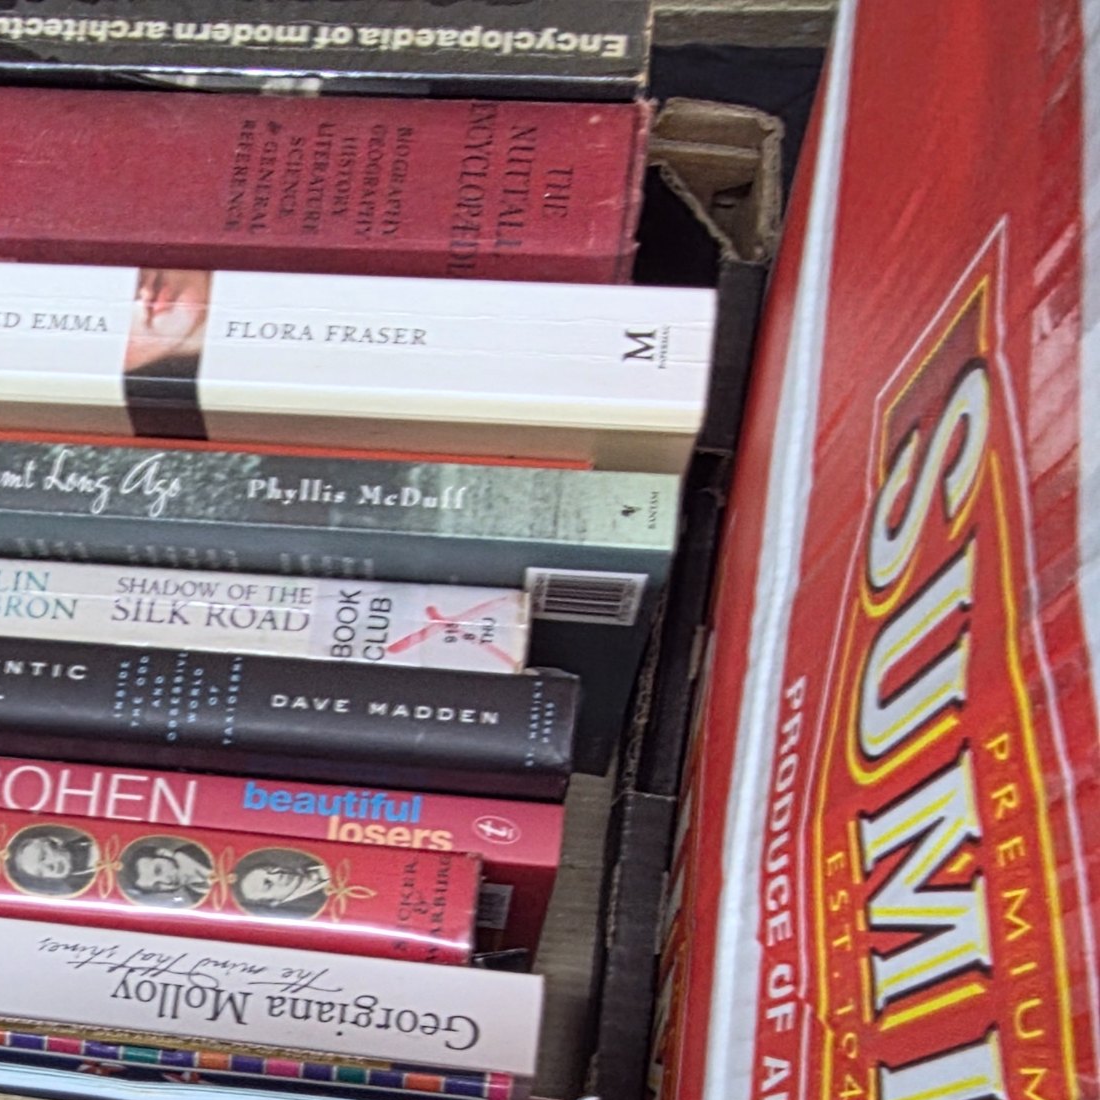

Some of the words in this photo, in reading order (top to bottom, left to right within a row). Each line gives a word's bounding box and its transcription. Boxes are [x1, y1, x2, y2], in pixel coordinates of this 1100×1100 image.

[173, 21, 311, 47] modern
[314, 24, 354, 50] of
[357, 26, 629, 58] Encyclopaedia
[223, 119, 256, 232] REFERENCE
[247, 140, 279, 235] GENERAL
[278, 136, 304, 220] SCIENCE
[301, 122, 336, 236] LITERATURE
[330, 136, 358, 220] HISTORY
[354, 124, 388, 239] GEOGRAPHY
[381, 126, 415, 237] BIOGRAPHY
[494, 124, 539, 250] NUTTALL
[543, 166, 574, 220] THE
[31, 312, 109, 333] EMMA
[226, 321, 315, 342] FLORA
[325, 324, 429, 347] FRASER
[622, 328, 657, 362] M
[42, 448, 111, 514] Long
[119, 452, 181, 517] Ago
[247, 476, 346, 506] Phyllis
[358, 485, 468, 511] McDuff
[110, 598, 190, 626] SILK
[205, 604, 311, 633] ROAD
[116, 576, 220, 598] SHADOW
[228, 583, 258, 601] OF
[264, 585, 313, 605] THE
[330, 589, 362, 658] BOOK
[362, 597, 393, 662] CLUB
[113, 659, 131, 718] INSIDE
[136, 655, 150, 687] ODD
[152, 674, 165, 708] AND
[187, 667, 204, 723] WORLD
[208, 685, 220, 706] OF
[131, 696, 143, 727] THE
[271, 694, 350, 713] DAVE
[368, 702, 500, 726] MADDEN
[243, 781, 423, 823] beautiful
[766, 676, 808, 947] PRODUCE
[327, 816, 453, 850] losers
[111, 971, 253, 1025] Molloy
[267, 989, 480, 1050] Georgiana
[765, 962, 793, 1034] OF
